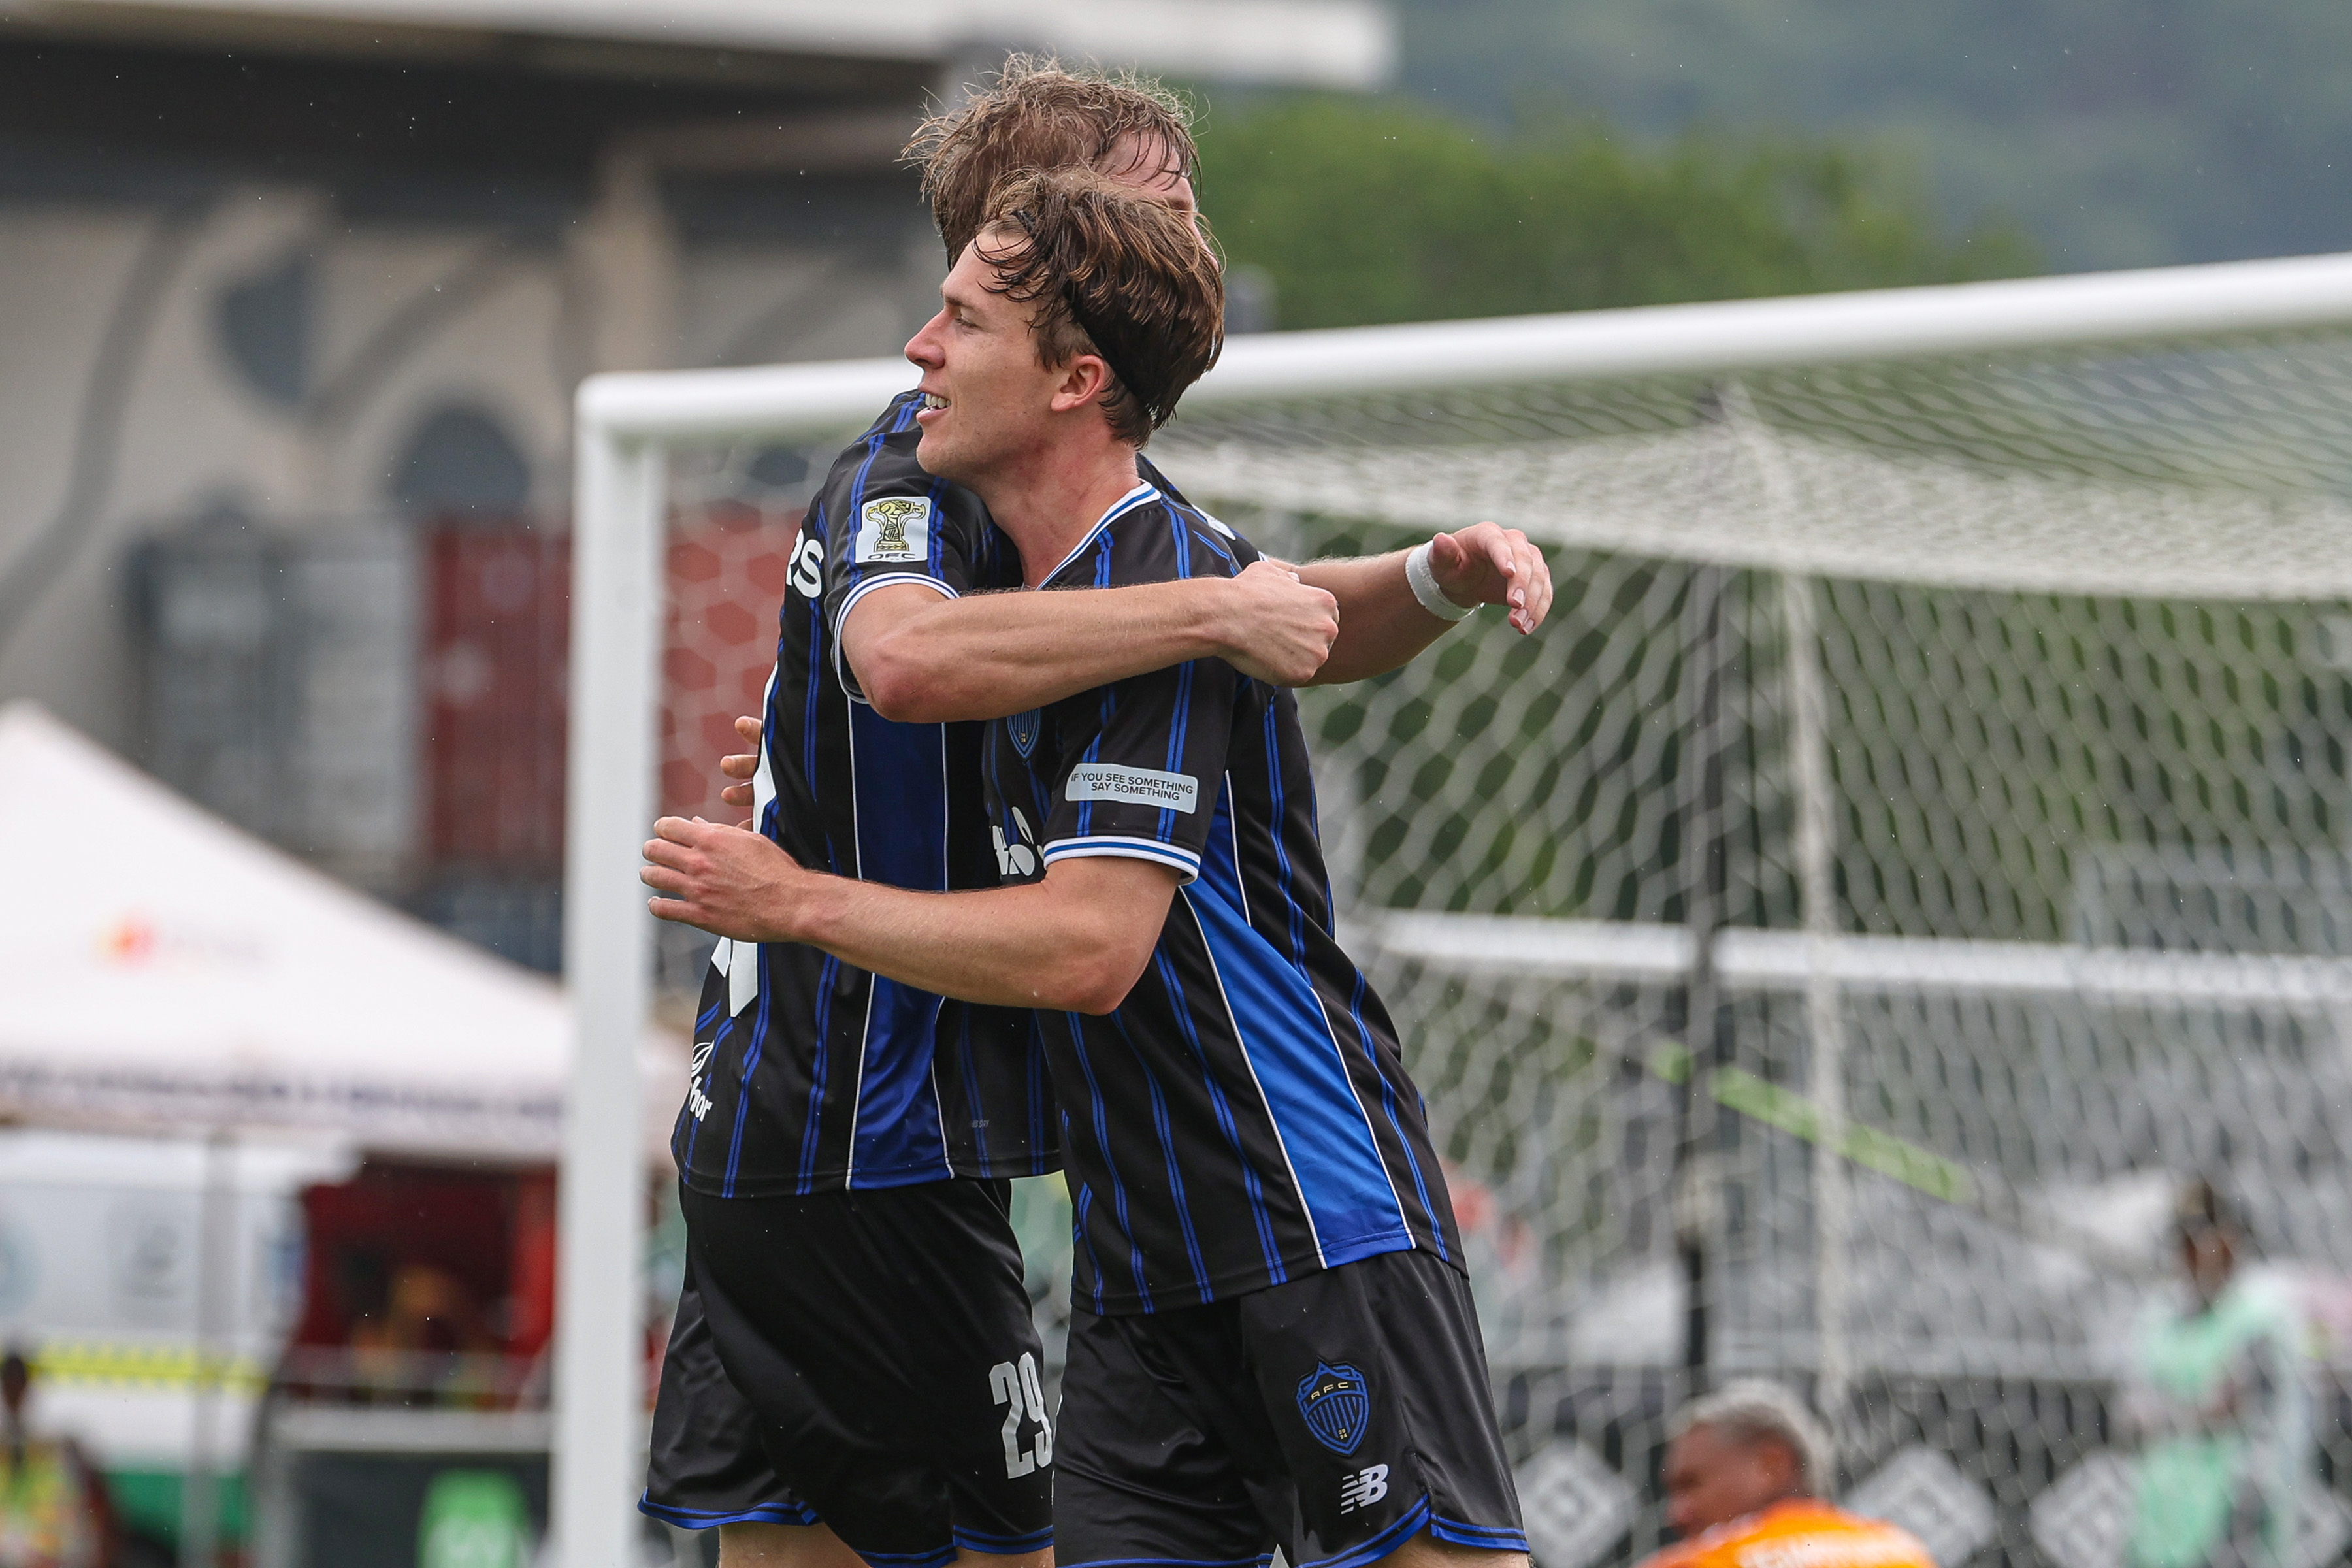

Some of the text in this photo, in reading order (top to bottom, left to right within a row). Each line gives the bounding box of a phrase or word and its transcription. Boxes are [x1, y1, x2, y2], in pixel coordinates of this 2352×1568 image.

[1071, 772, 1194, 794] IF YOU SEE SOMETHING
[1090, 781, 1180, 801] SAY SOMETHING
[689, 1075, 713, 1122] hor
[1311, 1382, 1349, 1400] AFC
[988, 1351, 1053, 1479] 29
